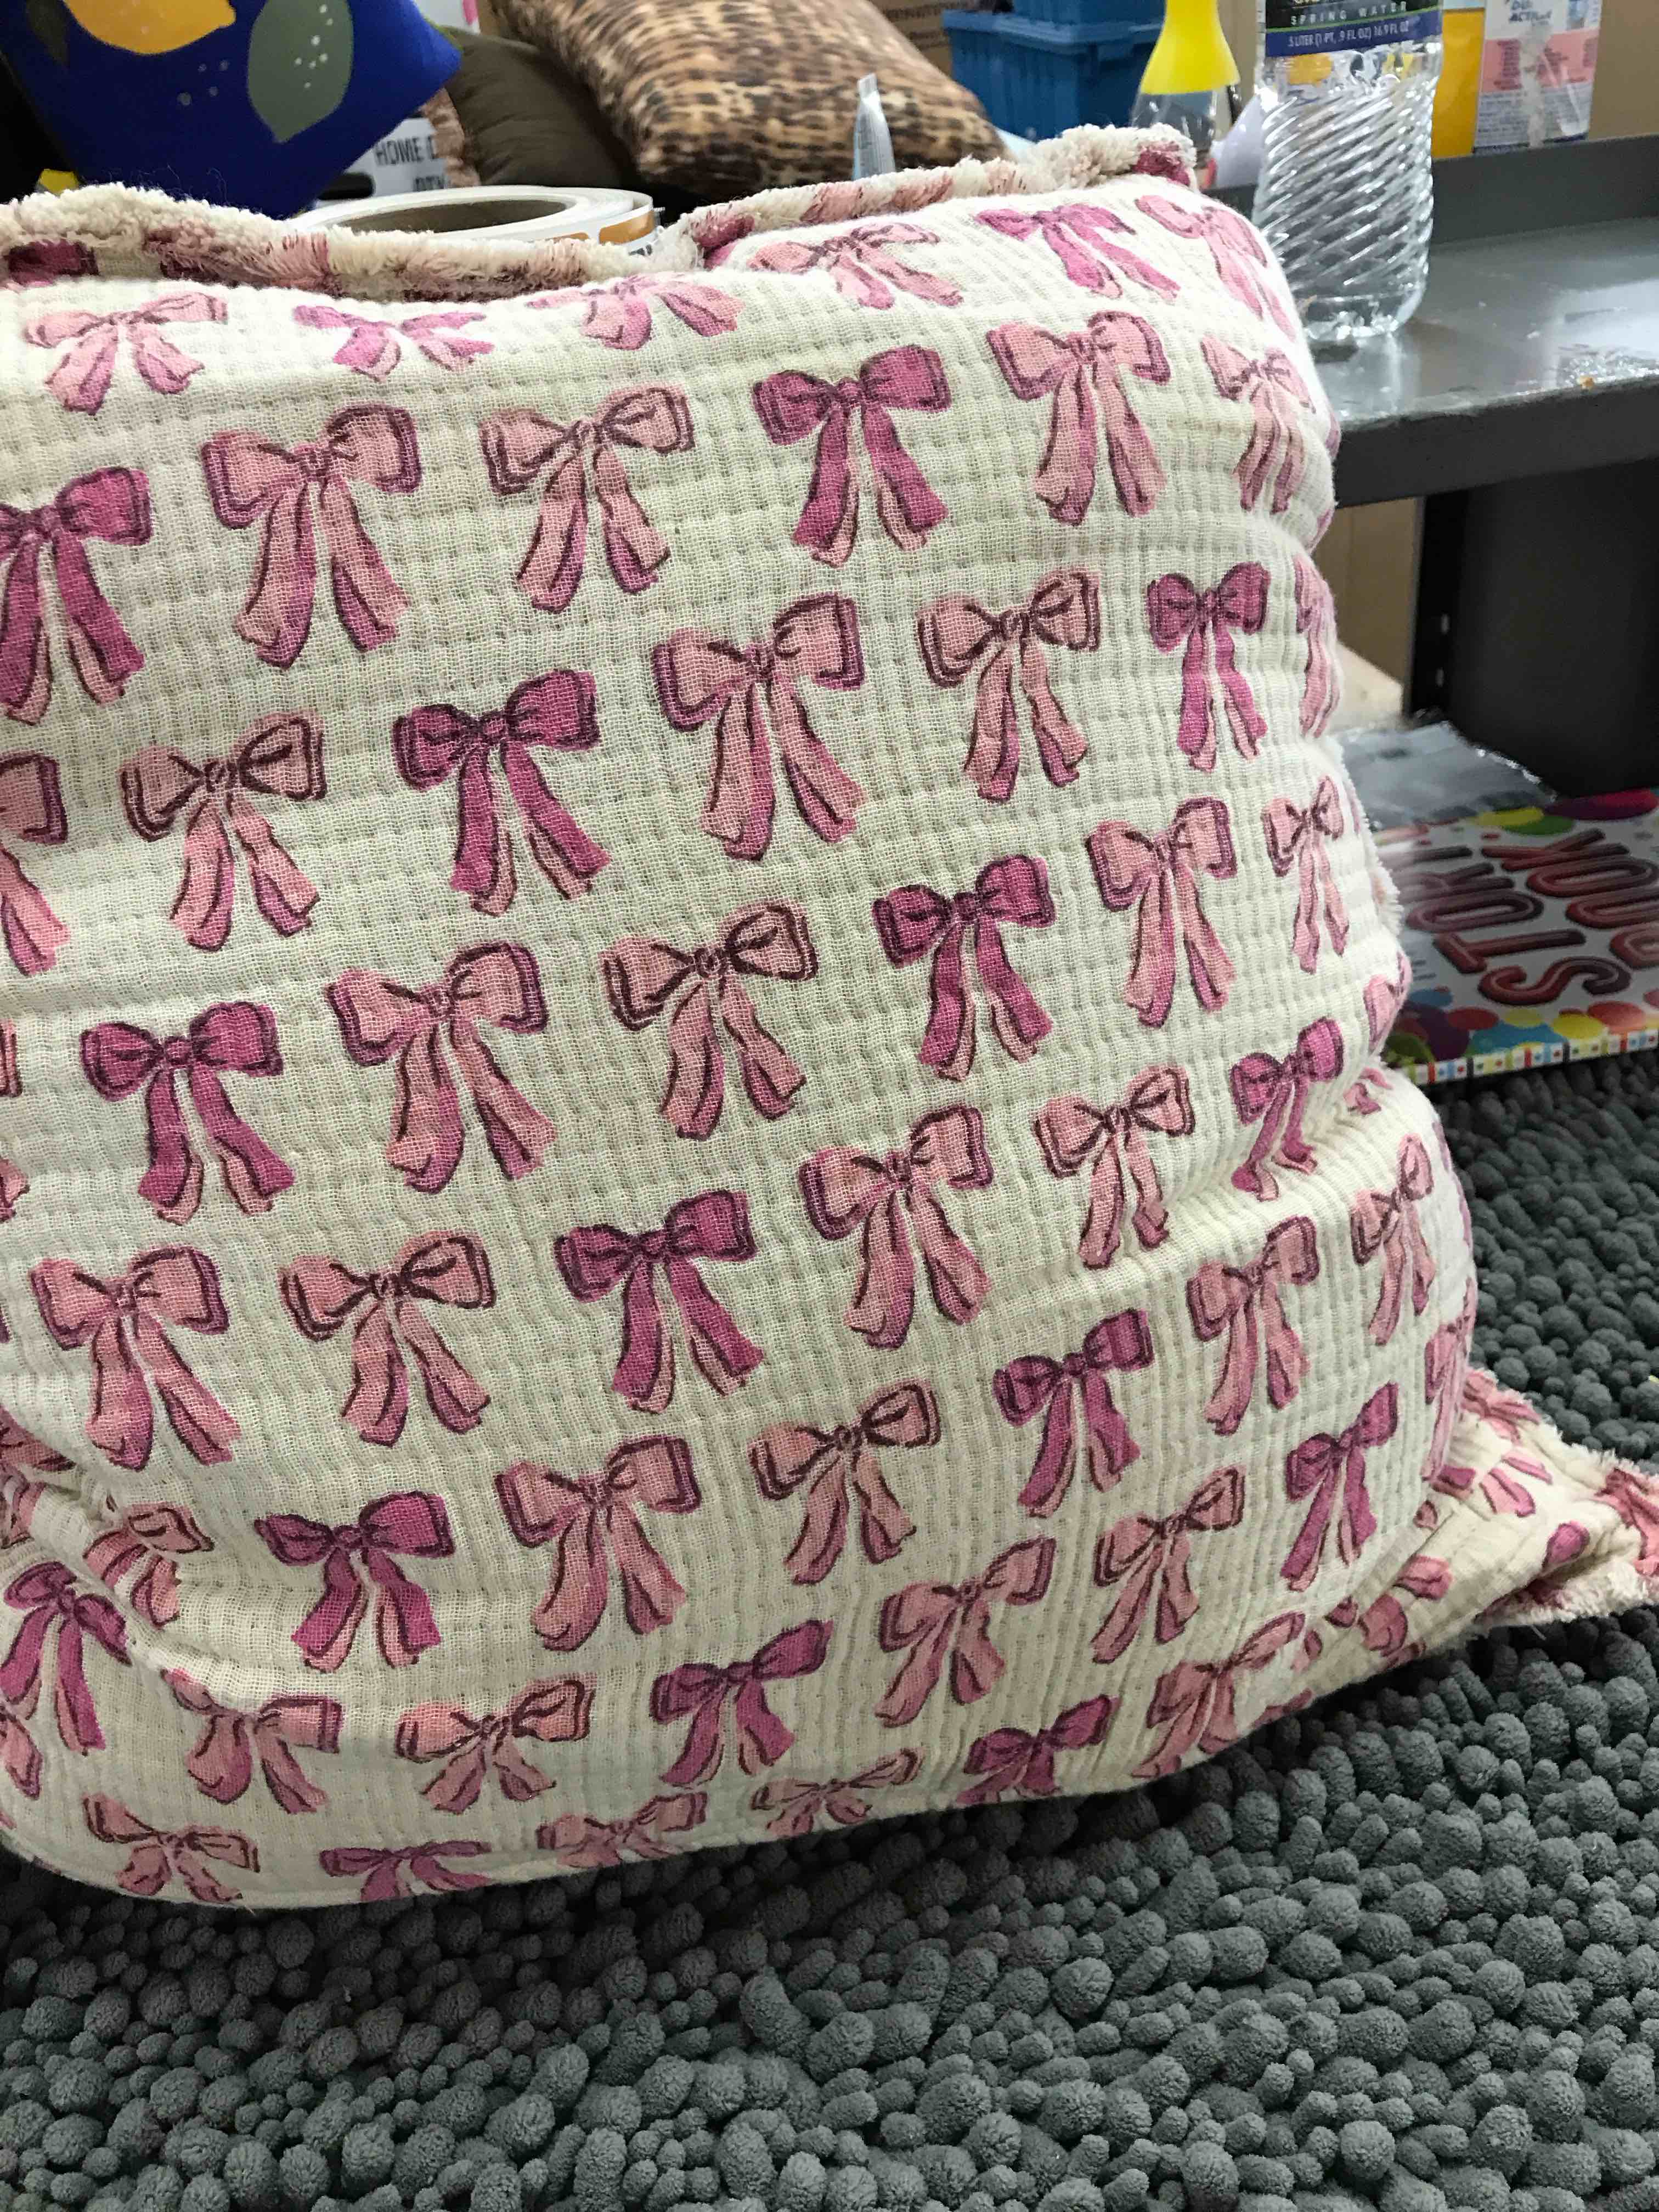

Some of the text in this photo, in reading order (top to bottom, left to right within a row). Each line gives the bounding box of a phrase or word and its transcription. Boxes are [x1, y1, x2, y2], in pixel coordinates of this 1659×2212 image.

[1290, 1, 1407, 25] SPRING WATER
[1295, 33, 1313, 46] LITER
[1347, 29, 1357, 40] FL
[1390, 23, 1398, 35] FL
[375, 137, 424, 166] HOME
